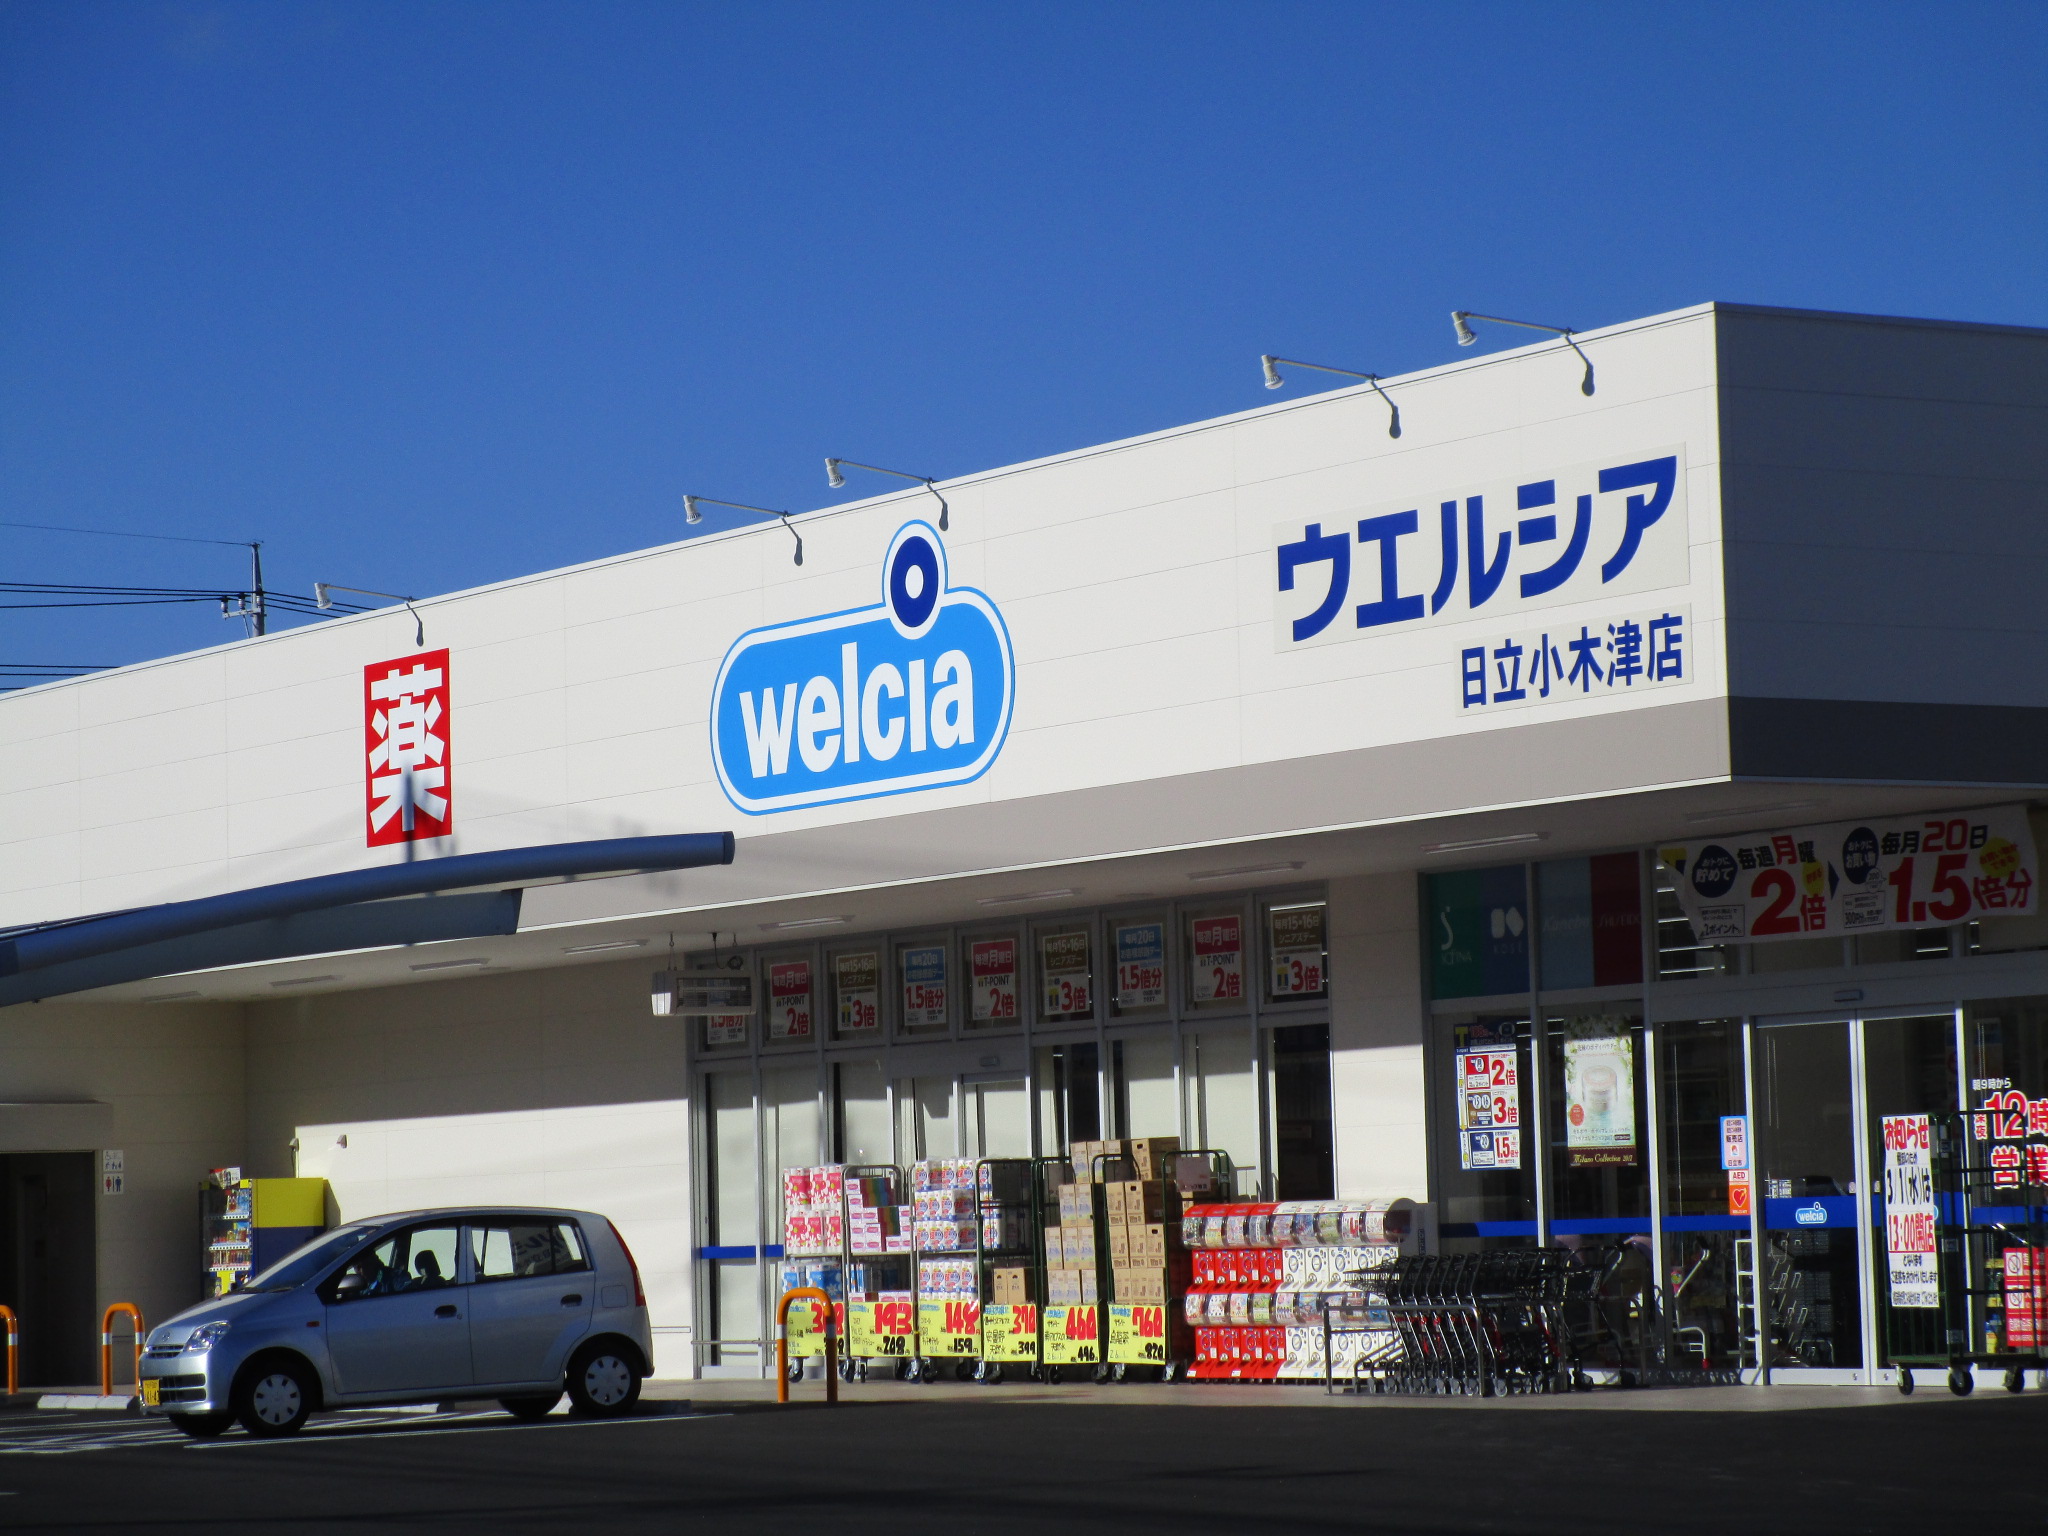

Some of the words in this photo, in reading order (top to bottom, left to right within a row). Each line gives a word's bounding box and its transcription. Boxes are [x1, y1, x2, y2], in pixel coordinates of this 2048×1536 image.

[1278, 455, 1677, 642] ウエルシア
[1461, 613, 1682, 708] 日立小木津店
[739, 641, 975, 779] welcia
[369, 663, 447, 834] 薬
[1881, 819, 1989, 855] 毎月20日
[1695, 868, 1733, 883] 貯めて
[1888, 853, 2032, 922] 1.5倍分
[1750, 868, 1827, 936] 2倍
[1196, 926, 1238, 947] 毎週月曜日
[975, 949, 1011, 968] 毎週月曜日
[774, 970, 807, 989] 毎週月曜日
[1120, 965, 1162, 990] 1.5倍分
[1213, 967, 1240, 998] 2倍
[1291, 960, 1320, 991] 3倍
[906, 985, 944, 1009] 1.5倍分
[990, 988, 1014, 1017] 2倍
[1061, 981, 1087, 1011] 3倍
[786, 1007, 809, 1036] 2倍
[853, 1000, 875, 1028] 3倍
[1492, 1059, 1516, 1086] 2倍
[1493, 1096, 1517, 1123] 3倍
[1884, 1117, 1930, 1151] お知らせ
[1798, 1210, 1824, 1222] welcia
[874, 1303, 913, 1335] 193
[1012, 1305, 1036, 1334] 370
[1066, 1306, 1097, 1340] 460
[1132, 1306, 1164, 1338] 760
